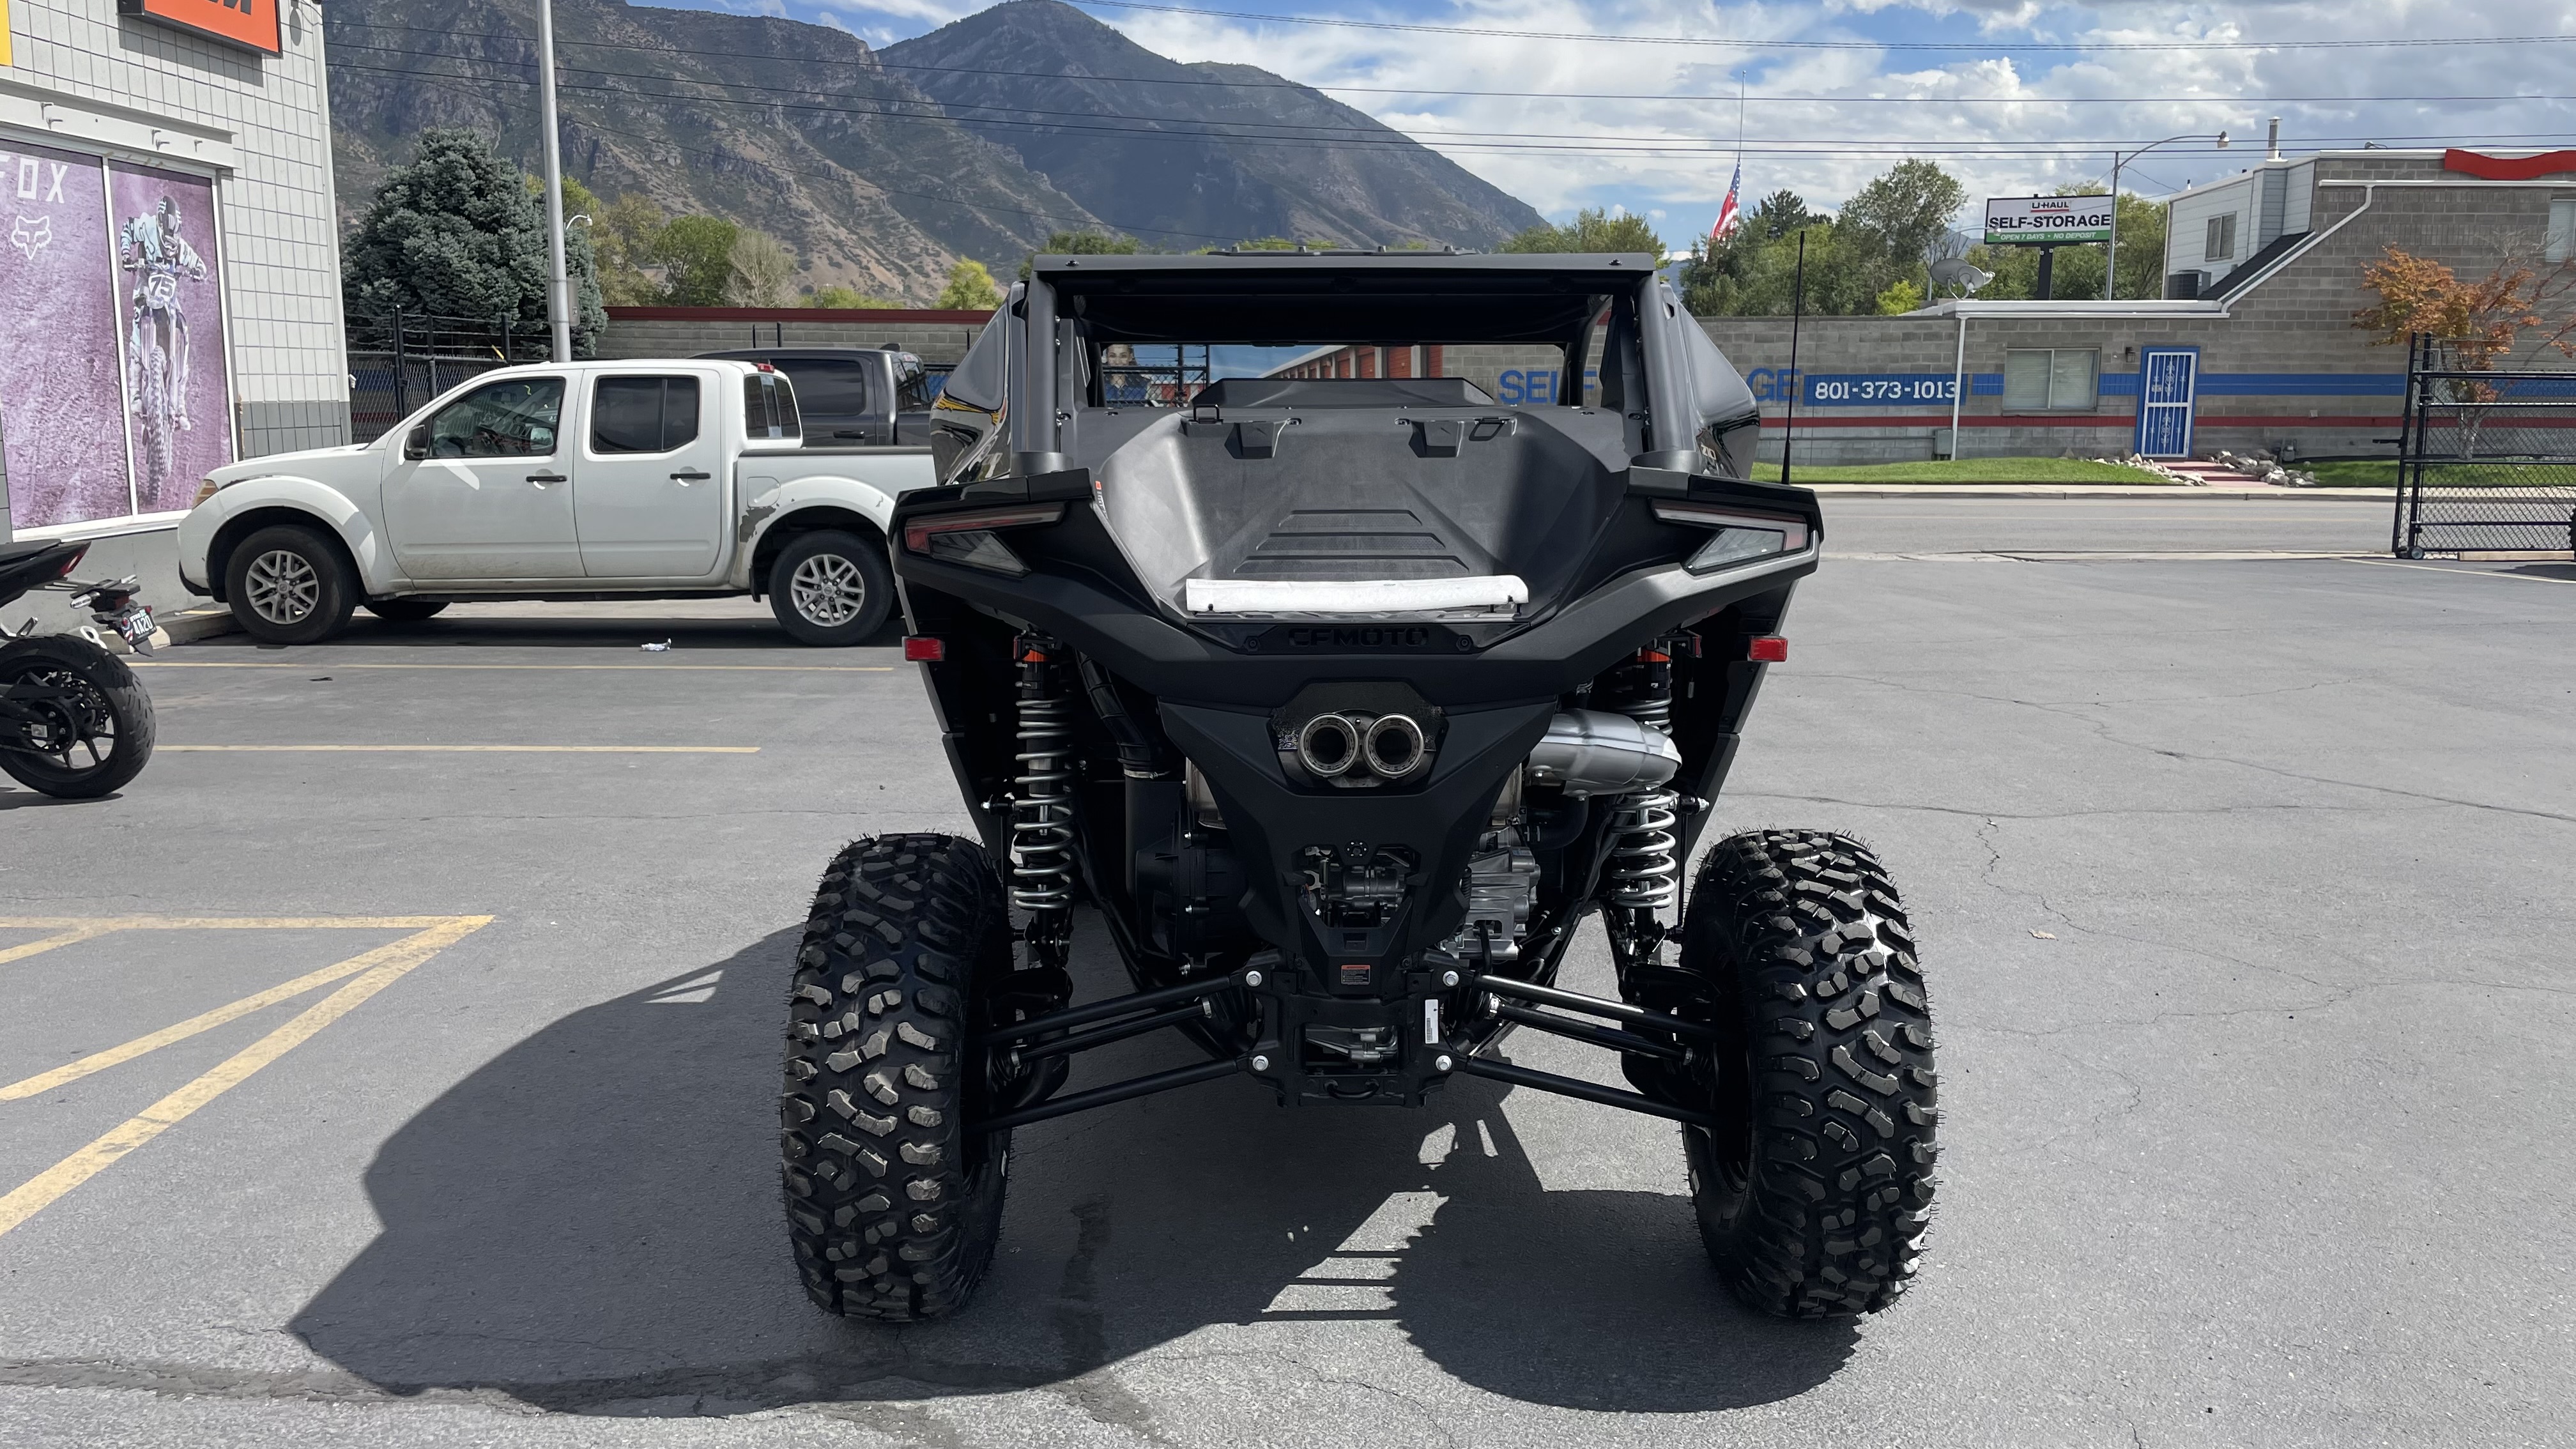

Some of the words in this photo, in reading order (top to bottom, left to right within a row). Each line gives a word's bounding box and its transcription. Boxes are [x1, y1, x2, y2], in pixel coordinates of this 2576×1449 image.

[1988, 214, 2111, 229] SELF-STORAGE
[150, 276, 174, 298] 75
[1814, 381, 1957, 400] 801-373-1013
[132, 615, 153, 635] 4A20
[1288, 627, 1430, 647] CFMOTO
